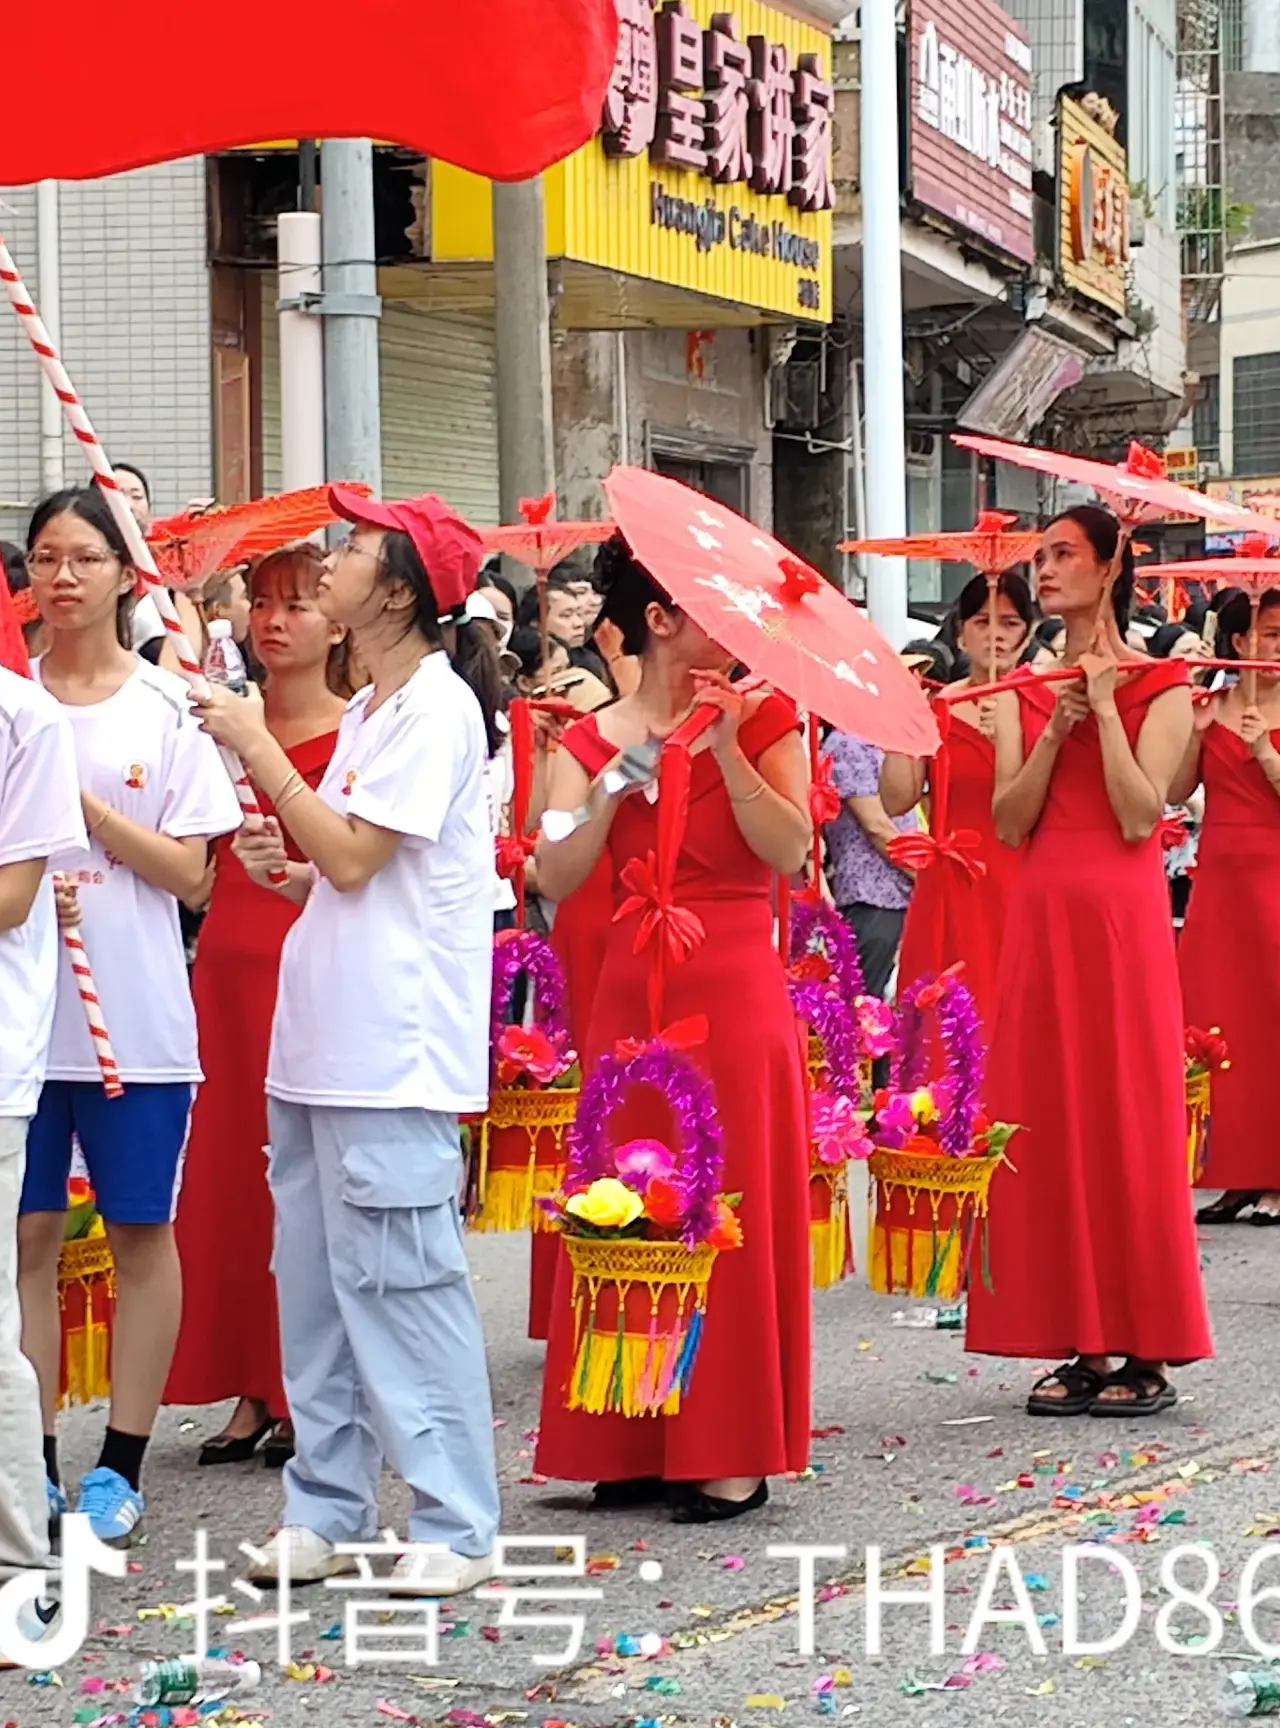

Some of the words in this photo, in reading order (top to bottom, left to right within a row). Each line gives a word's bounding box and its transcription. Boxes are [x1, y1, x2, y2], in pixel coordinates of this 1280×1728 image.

[654, 0, 836, 212] 皇家饼家
[729, 205, 770, 257] Cake
[773, 220, 820, 271] House
